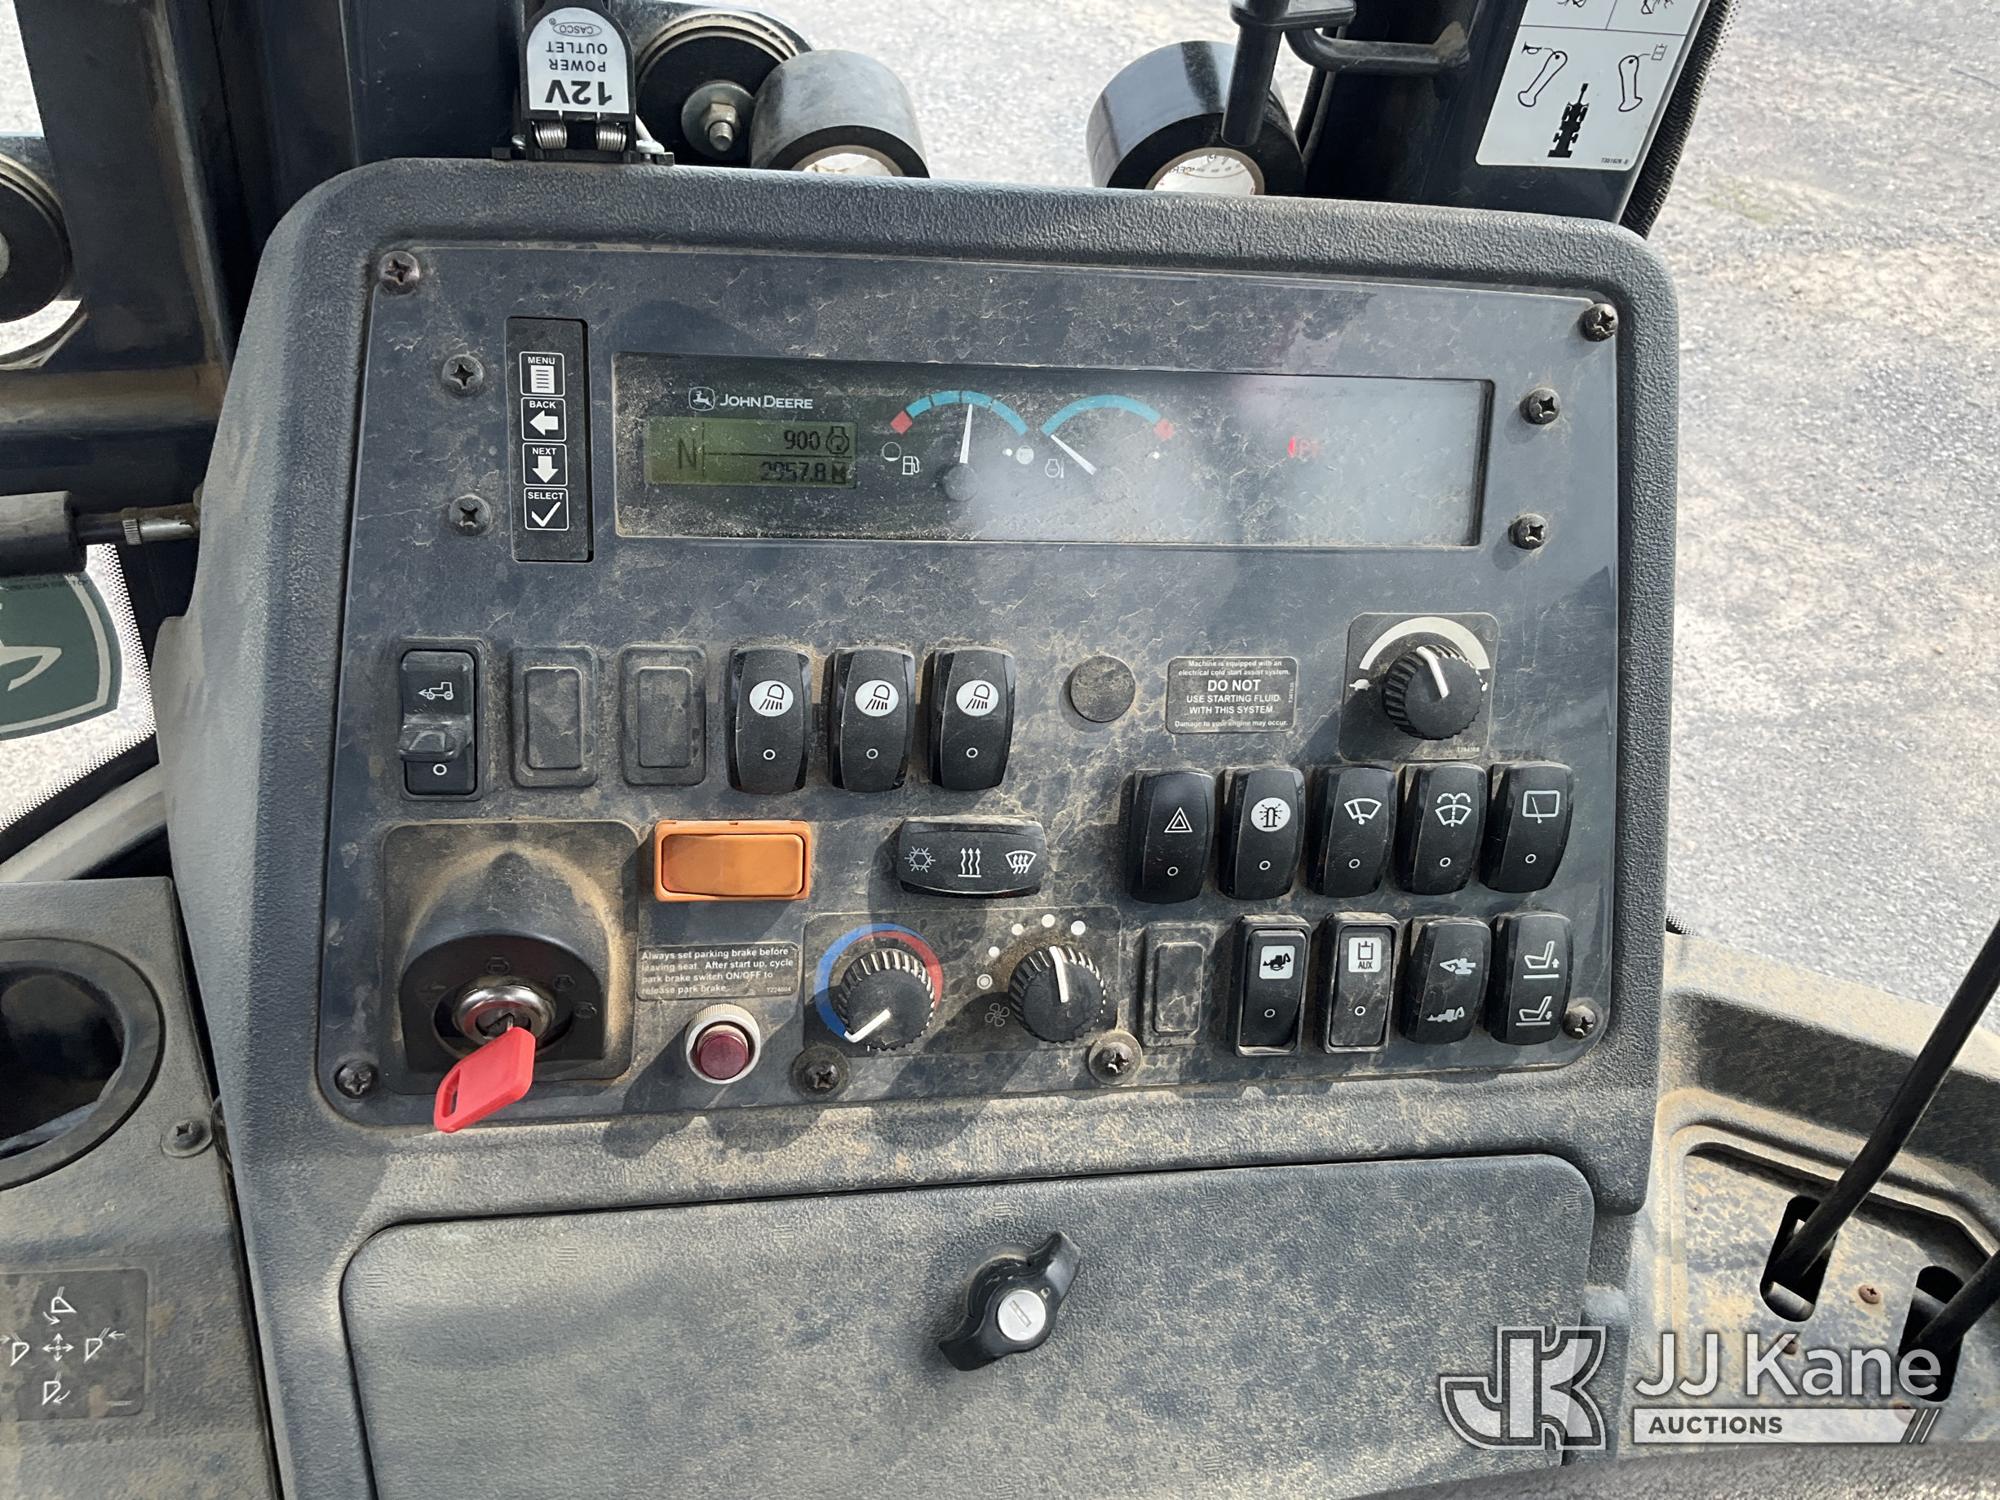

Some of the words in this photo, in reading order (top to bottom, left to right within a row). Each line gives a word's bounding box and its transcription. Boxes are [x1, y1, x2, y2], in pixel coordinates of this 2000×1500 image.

[560, 24, 594, 34] CASCO
[546, 41, 608, 55] OUTLET
[549, 59, 606, 72] POWER
[545, 80, 612, 106] 12V
[528, 356, 556, 365] MENU
[529, 400, 556, 409] BACK
[784, 430, 821, 450] 900
[532, 447, 557, 455] NEXT
[677, 438, 698, 470] N
[528, 492, 564, 500] SELECT
[1226, 660, 1256, 668] equipped
[1207, 680, 1228, 691] DO
[1232, 679, 1261, 691] NOT
[1186, 695, 1205, 703] USE
[1206, 694, 1252, 703] STARTING
[1254, 694, 1280, 703] FLUID
[1189, 706, 1212, 714] WITH
[1214, 706, 1235, 714] THIS
[1237, 705, 1273, 714] SYSTEM
[1174, 720, 1202, 728] Damage
[642, 951, 675, 961] Always
[678, 951, 693, 959] set
[694, 950, 729, 960] parking
[731, 948, 757, 957] brake
[759, 947, 789, 956] before
[641, 963, 676, 973] leaving
[705, 961, 728, 970] After
[730, 960, 751, 969] start
[769, 958, 794, 967] cycle
[1358, 961, 1373, 969] AUX
[641, 974, 663, 984] park
[665, 974, 691, 983] brake
[693, 972, 723, 982] switch
[725, 971, 761, 981] ON/OFF
[764, 970, 773, 979] to
[641, 985, 675, 995] release
[677, 985, 698, 995] park
